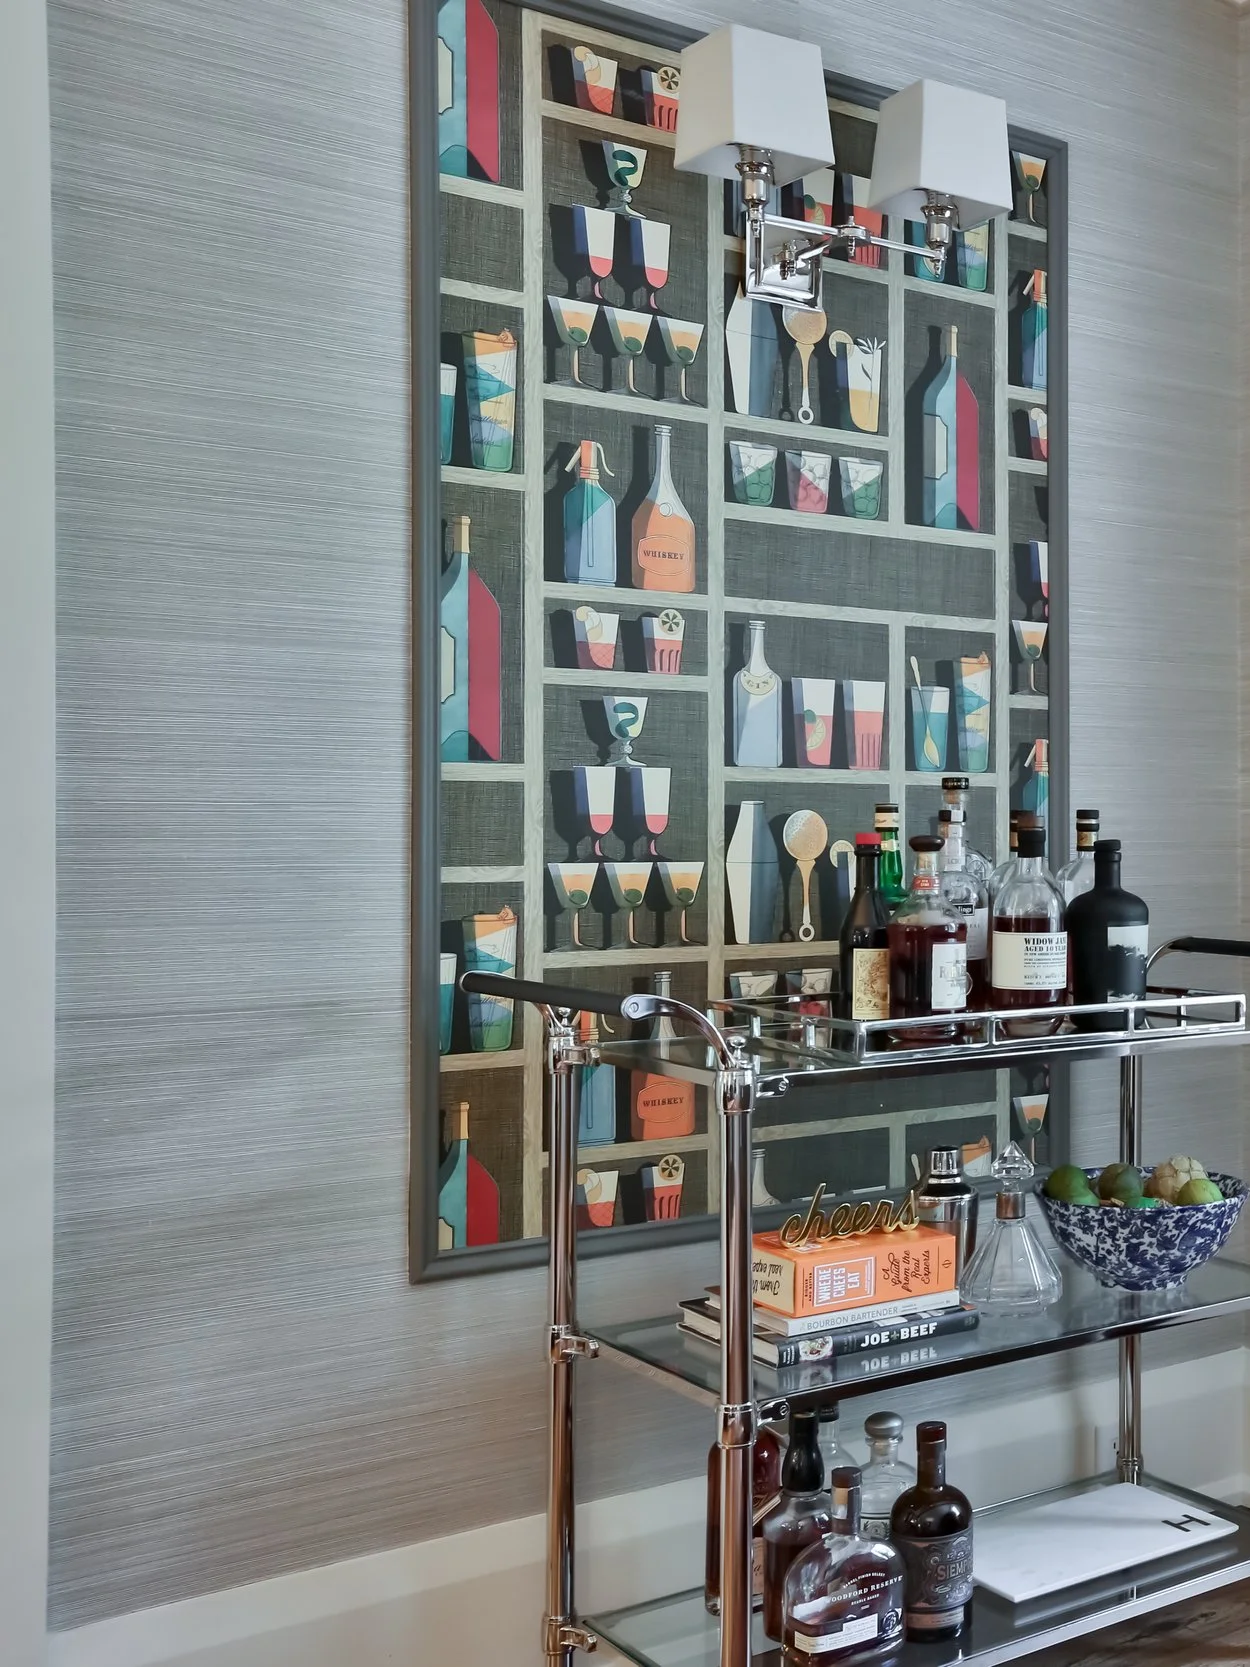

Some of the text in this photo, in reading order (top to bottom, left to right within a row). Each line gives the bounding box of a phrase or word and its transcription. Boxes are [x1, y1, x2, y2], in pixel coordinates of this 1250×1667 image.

[643, 550, 684, 560] WHISKEY
[746, 679, 769, 689] GIN
[1024, 937, 1054, 945] WIDOW
[643, 1097, 684, 1107] WHISKEY
[780, 1183, 919, 1248] cheers
[901, 1250, 910, 1265] the
[910, 1258, 922, 1279] Real
[921, 1250, 931, 1285] Experts
[847, 1272, 860, 1289] EAT
[881, 1268, 890, 1280] A
[887, 1252, 903, 1287] Guide
[901, 1267, 913, 1293] from
[818, 1267, 832, 1303] WHERE
[832, 1267, 846, 1298] CHEFS
[807, 1315, 849, 1330] BOURBON
[850, 1306, 898, 1322] BARTENDER
[860, 1331, 890, 1348] JOE
[900, 1322, 937, 1340] BEEF
[1161, 1514, 1211, 1532] H
[831, 1575, 903, 1602] OODFORD RESERVE
